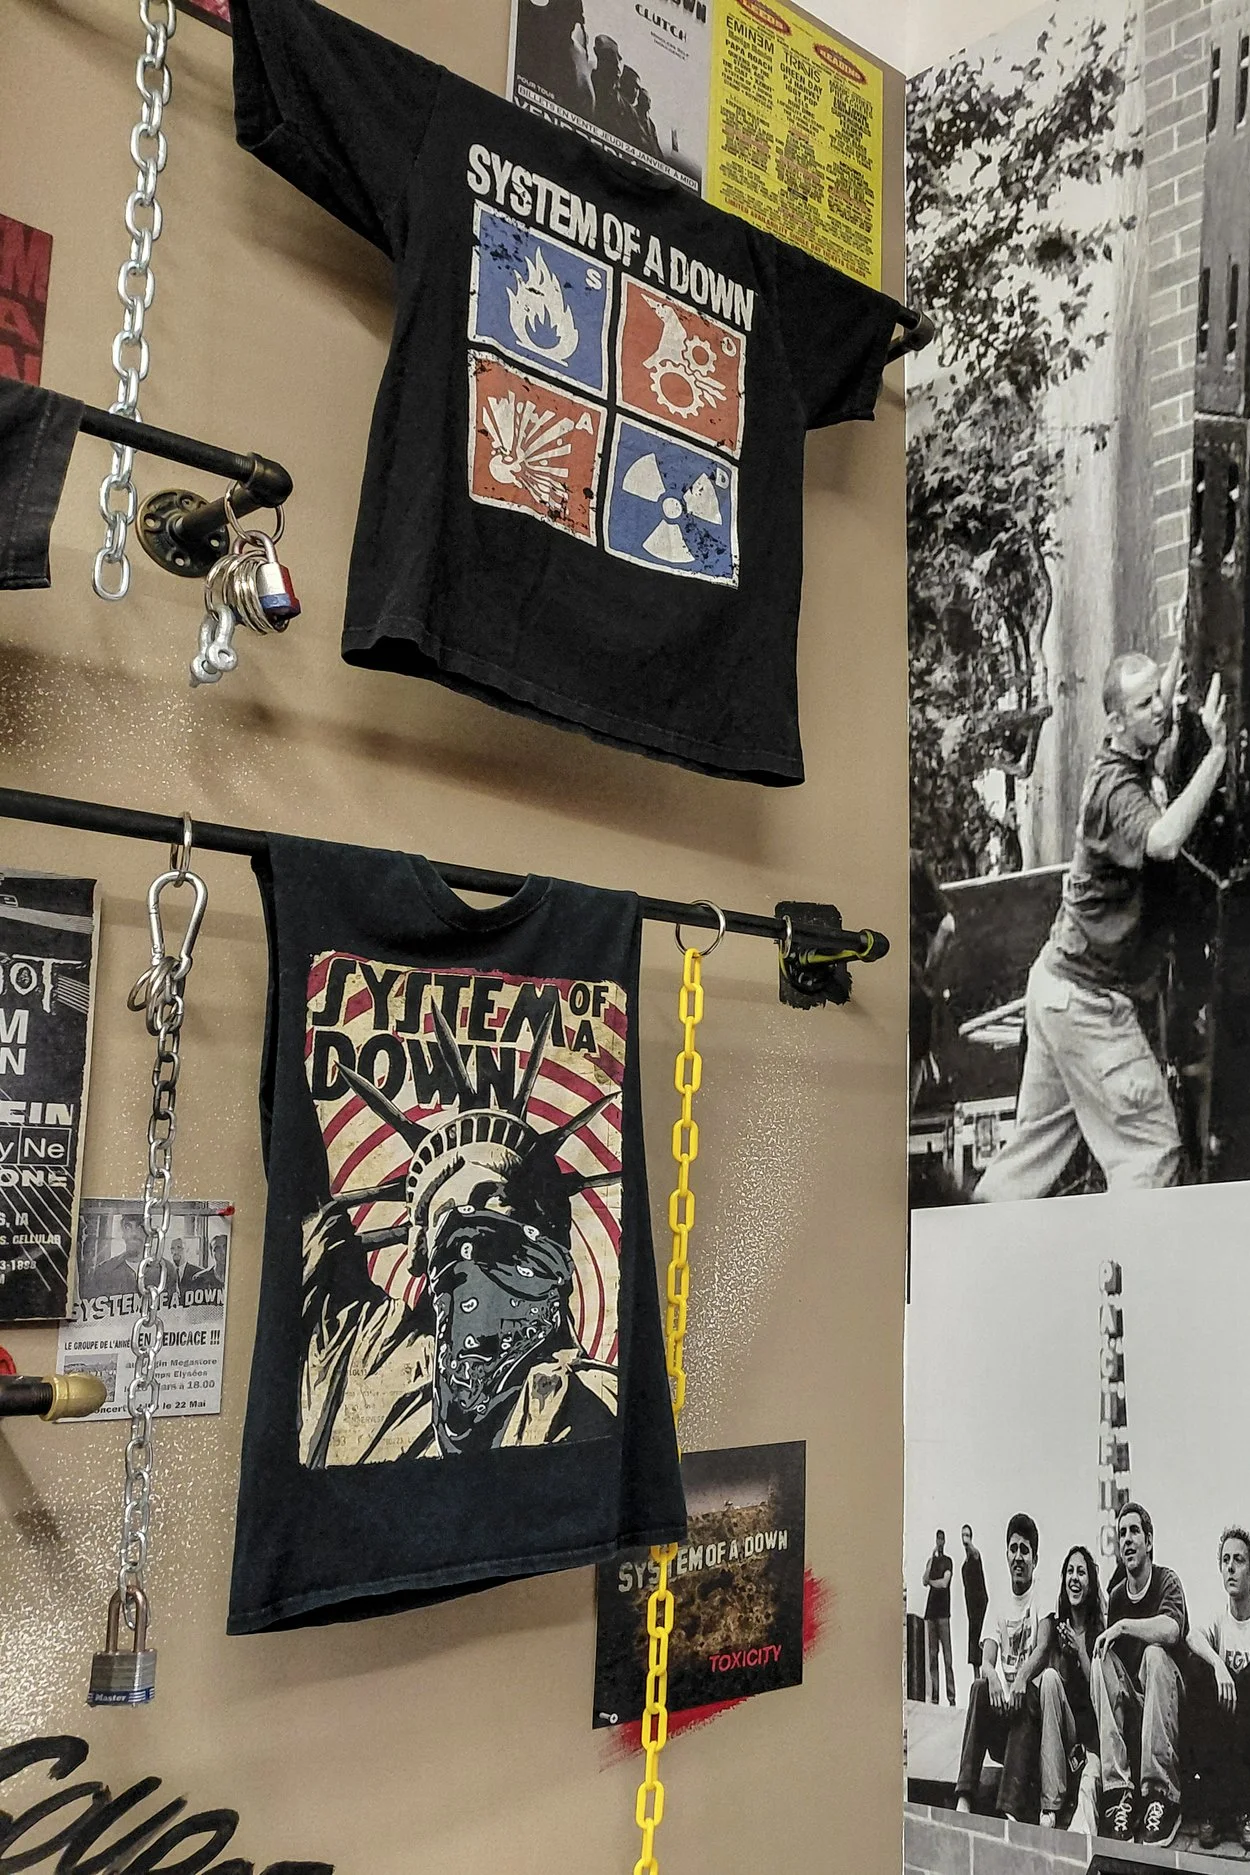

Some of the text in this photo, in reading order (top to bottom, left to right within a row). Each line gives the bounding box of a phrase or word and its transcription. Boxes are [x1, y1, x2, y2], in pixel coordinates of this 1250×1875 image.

[634, 4, 687, 43] CLUTCH
[725, 38, 744, 56] PAPA
[747, 51, 772, 73] ROACH
[780, 61, 822, 95] GREEN DAY
[519, 86, 555, 113] BILLETS
[556, 107, 569, 119] EN
[570, 113, 598, 135] VENTE
[600, 129, 624, 149] JEUDI
[625, 144, 636, 156] 24
[637, 149, 671, 174] JANVIER
[680, 174, 698, 189] MIDI
[466, 143, 756, 332] SYSTEM OF A DOWN
[312, 958, 609, 1048] SYSTEM OF
[574, 1020, 597, 1053] A
[312, 1030, 517, 1111] DOWN
[169, 1292, 181, 1309] A
[184, 1288, 224, 1308] DOWN
[64, 1342, 72, 1350] LE
[74, 1341, 98, 1350] GROUPE
[100, 1340, 108, 1349] DE
[138, 1332, 152, 1347] EN
[163, 1331, 207, 1347] EDICACE
[187, 1380, 216, 1390] 18.00
[174, 1401, 186, 1409] 22
[189, 1400, 206, 1408] Mai
[618, 1529, 789, 1593] SYSTEM OF A DOWN
[709, 1644, 783, 1674] TOXICITY
[95, 1693, 127, 1702] Master
